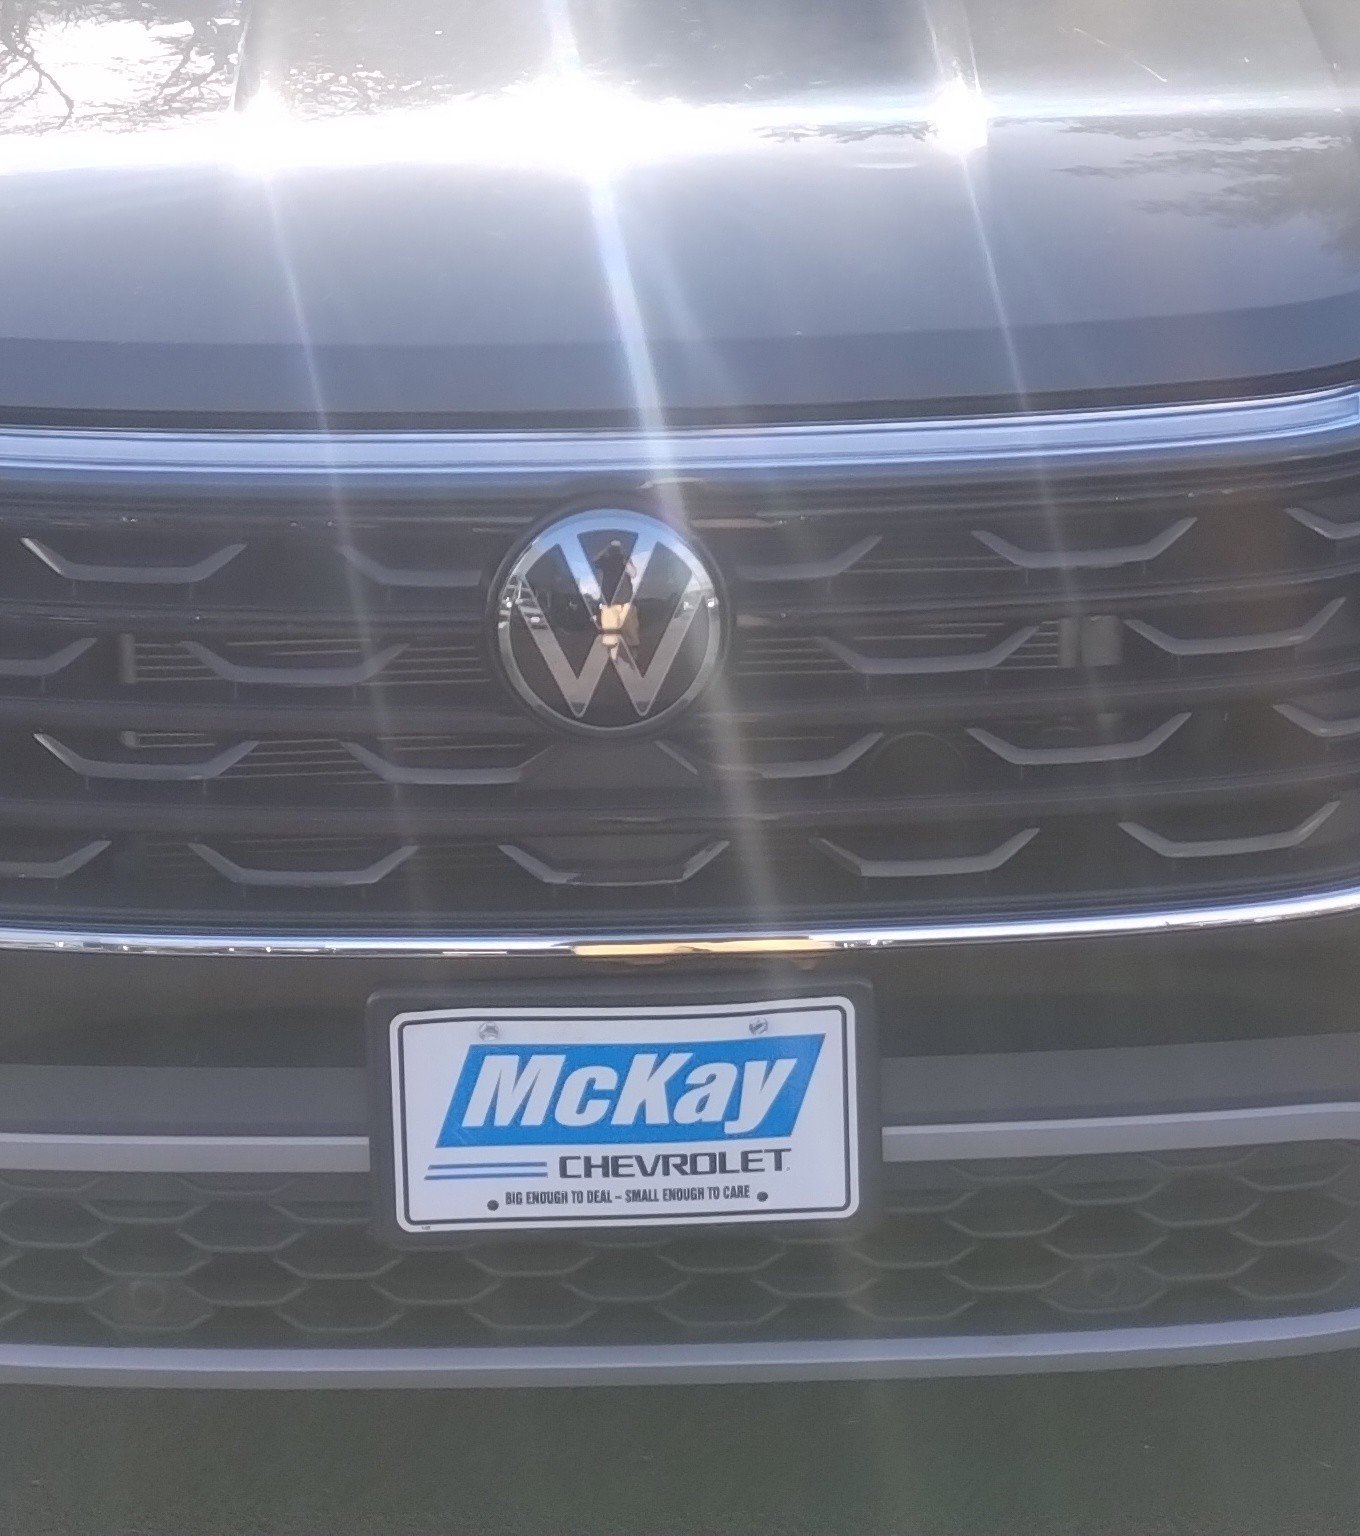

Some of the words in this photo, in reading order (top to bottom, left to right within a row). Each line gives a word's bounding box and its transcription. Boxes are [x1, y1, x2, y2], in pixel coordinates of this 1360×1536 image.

[462, 1052, 798, 1134] McKay
[559, 1148, 792, 1179] CHEVROLET
[505, 1191, 523, 1205] BIG
[526, 1190, 568, 1204] ENOUGH
[571, 1189, 584, 1203] TO
[587, 1189, 612, 1203] DEAL
[625, 1188, 659, 1203] SMALL
[662, 1186, 705, 1202] ENOUGH
[707, 1186, 720, 1200] TO
[723, 1184, 750, 1199] CARE
